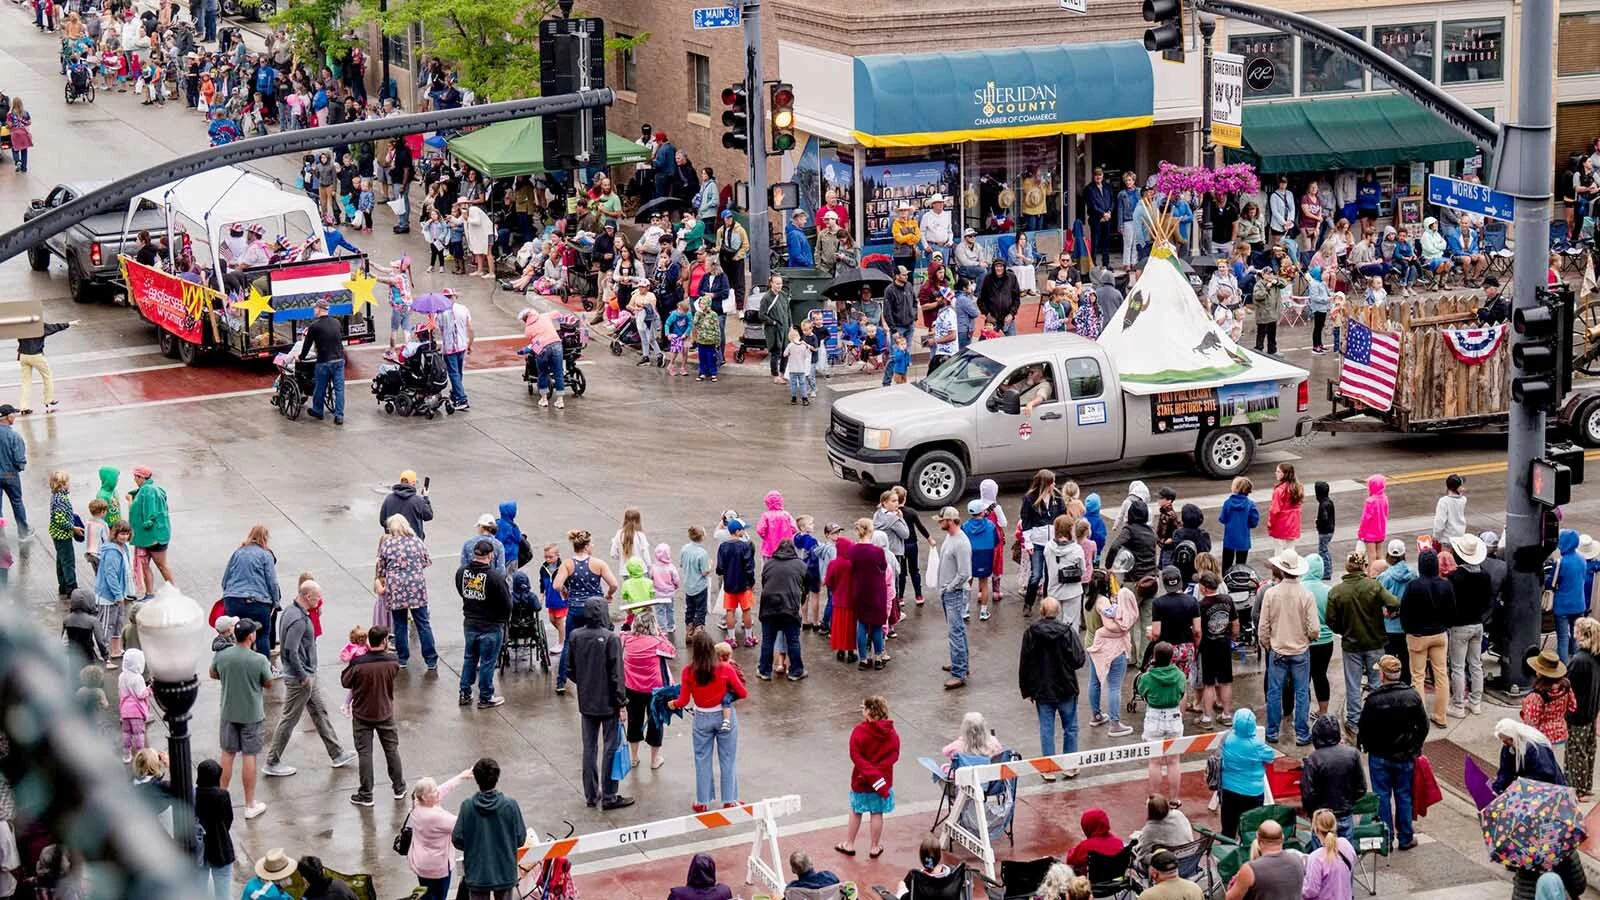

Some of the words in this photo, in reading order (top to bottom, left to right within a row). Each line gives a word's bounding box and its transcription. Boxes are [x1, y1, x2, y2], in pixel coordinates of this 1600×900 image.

[696, 10, 703, 20] S
[705, 8, 725, 19] MAIN
[727, 7, 738, 18] ST
[1246, 43, 1274, 54] ROSE
[1214, 62, 1243, 77] SHERIDAN
[974, 82, 1057, 105] SHERIDAN
[1214, 82, 1241, 113] WYO
[996, 100, 1057, 114] COUNTY
[974, 117, 1007, 126] CHAMBER
[1008, 115, 1018, 124] OF
[1019, 113, 1057, 123] COMMERCE
[1451, 181, 1479, 200] WORKS
[1481, 188, 1492, 203] ST
[1156, 404, 1174, 416] STATE
[1174, 400, 1203, 415] HISTORIC
[1203, 399, 1217, 412] SITE
[1078, 752, 1106, 765] DEPT
[1109, 746, 1150, 762] STREET
[619, 829, 648, 843] CITY
[944, 823, 967, 846] STREET
